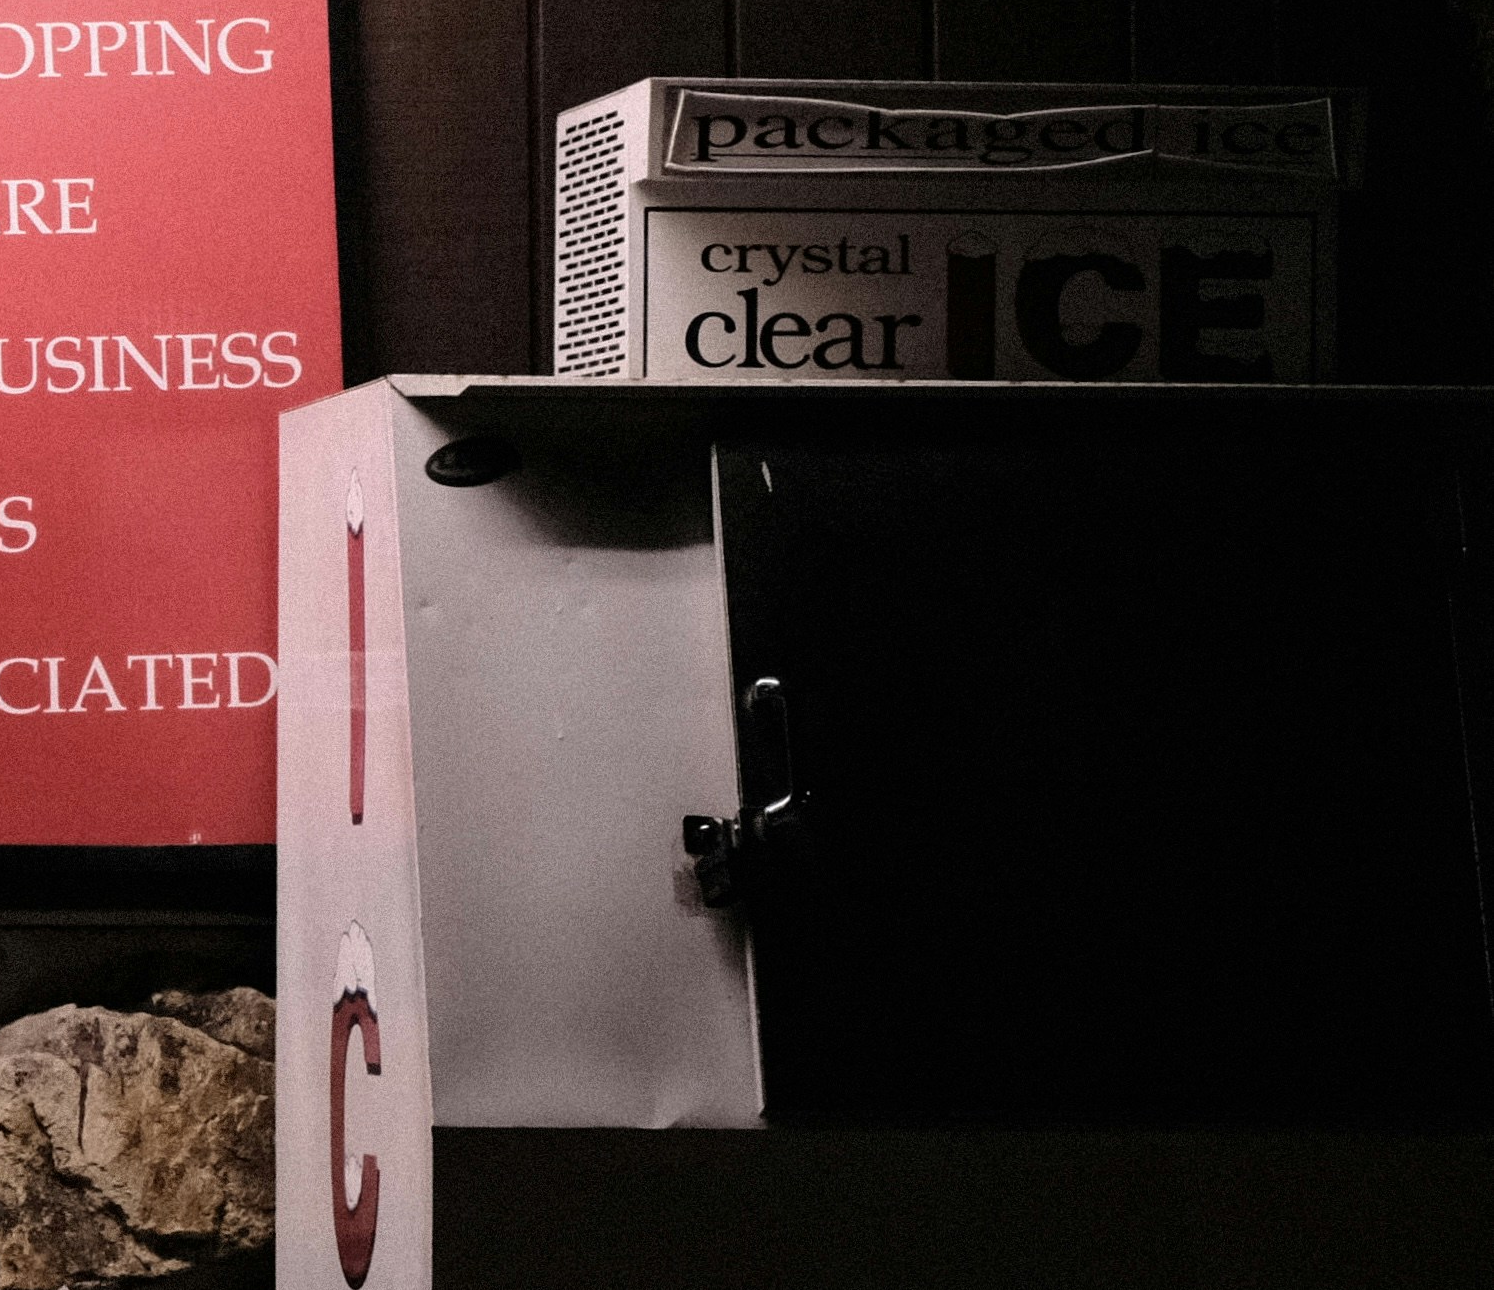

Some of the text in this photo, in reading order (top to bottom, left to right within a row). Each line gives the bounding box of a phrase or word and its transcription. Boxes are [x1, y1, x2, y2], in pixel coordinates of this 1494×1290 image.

[693, 105, 1320, 166] packaged ice
[700, 234, 913, 286] crystal
[686, 230, 1274, 381] clear ICE
